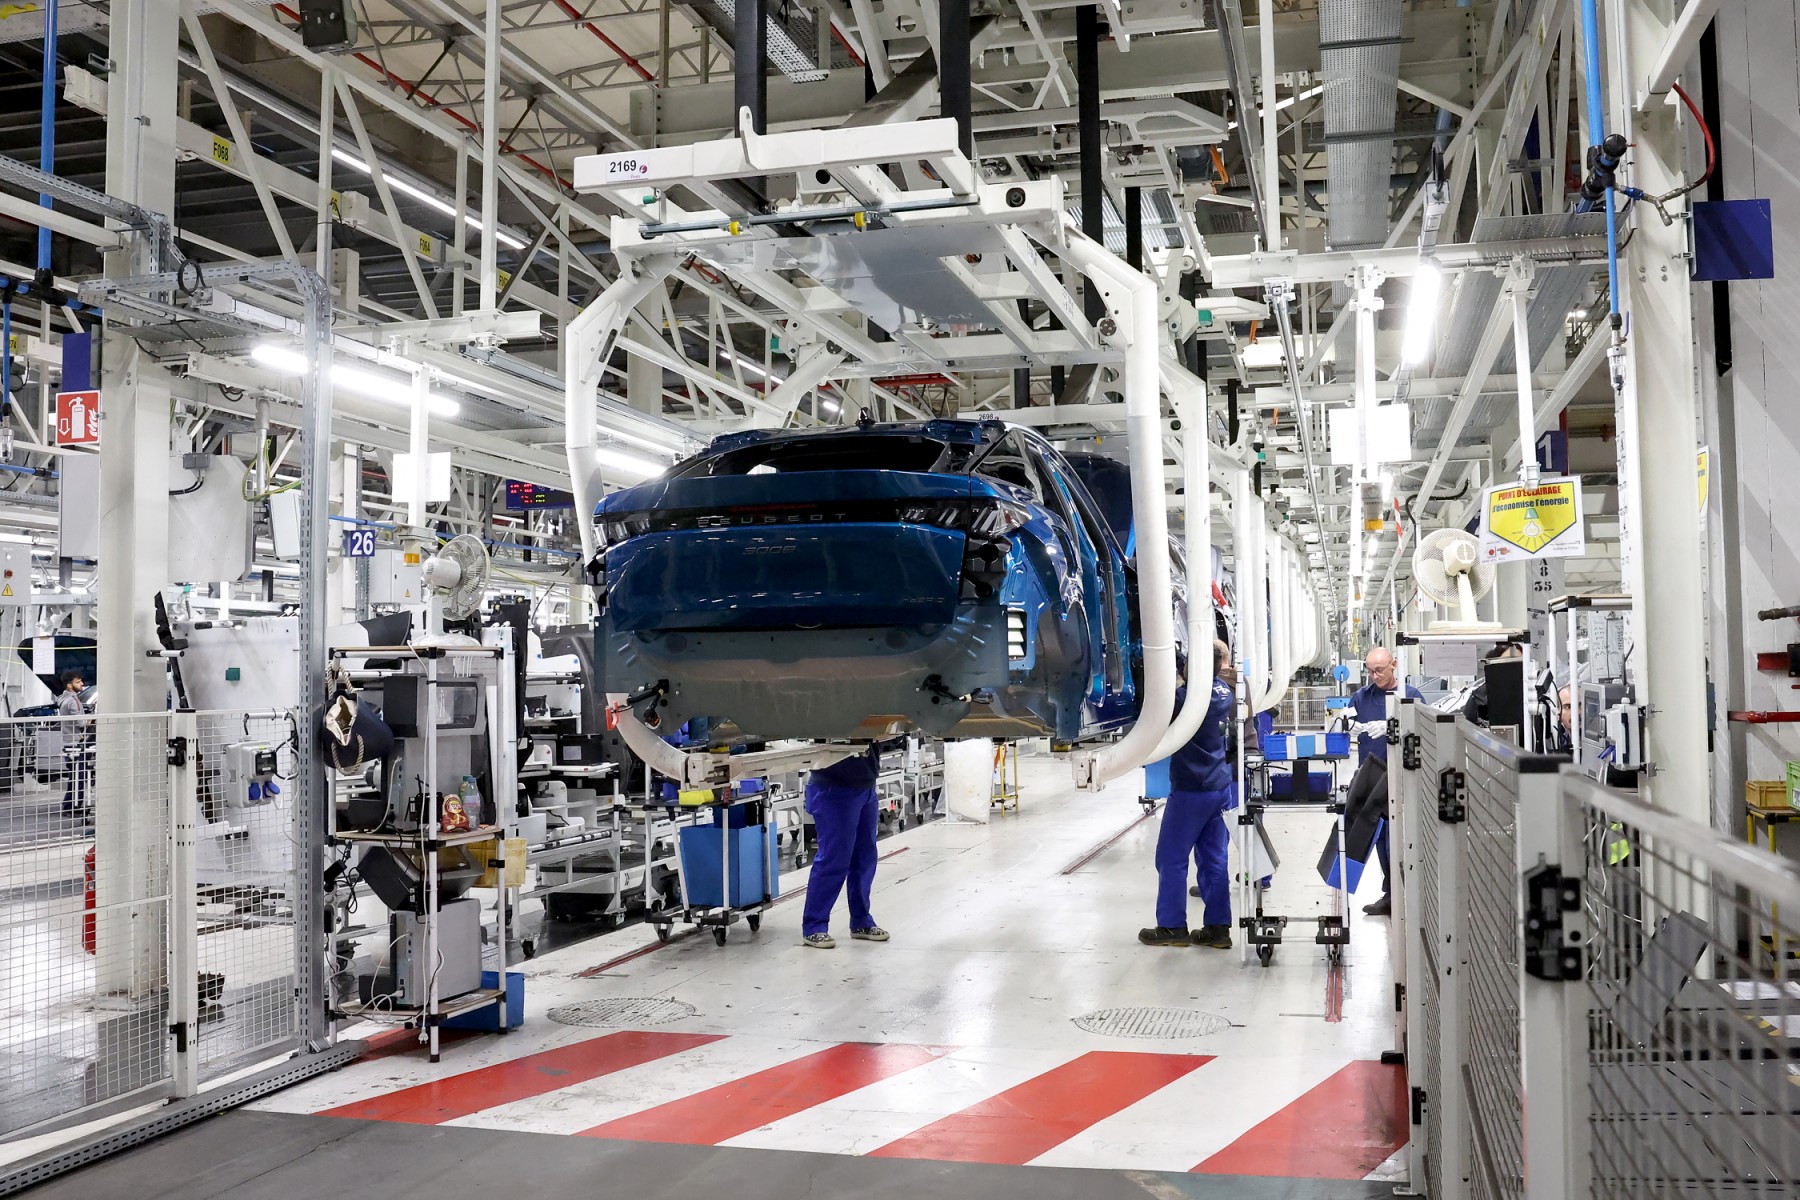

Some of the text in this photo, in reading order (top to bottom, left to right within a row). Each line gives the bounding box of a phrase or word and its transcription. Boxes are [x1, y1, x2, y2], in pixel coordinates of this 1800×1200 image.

[609, 159, 637, 173] 2169
[1538, 434, 1553, 469] 1
[1498, 491, 1516, 501] POINT
[697, 513, 847, 528] PEUGEOT
[351, 531, 374, 556] 26
[1539, 558, 1549, 566] A
[1540, 566, 1549, 577] 8
[1534, 580, 1553, 592] 35
